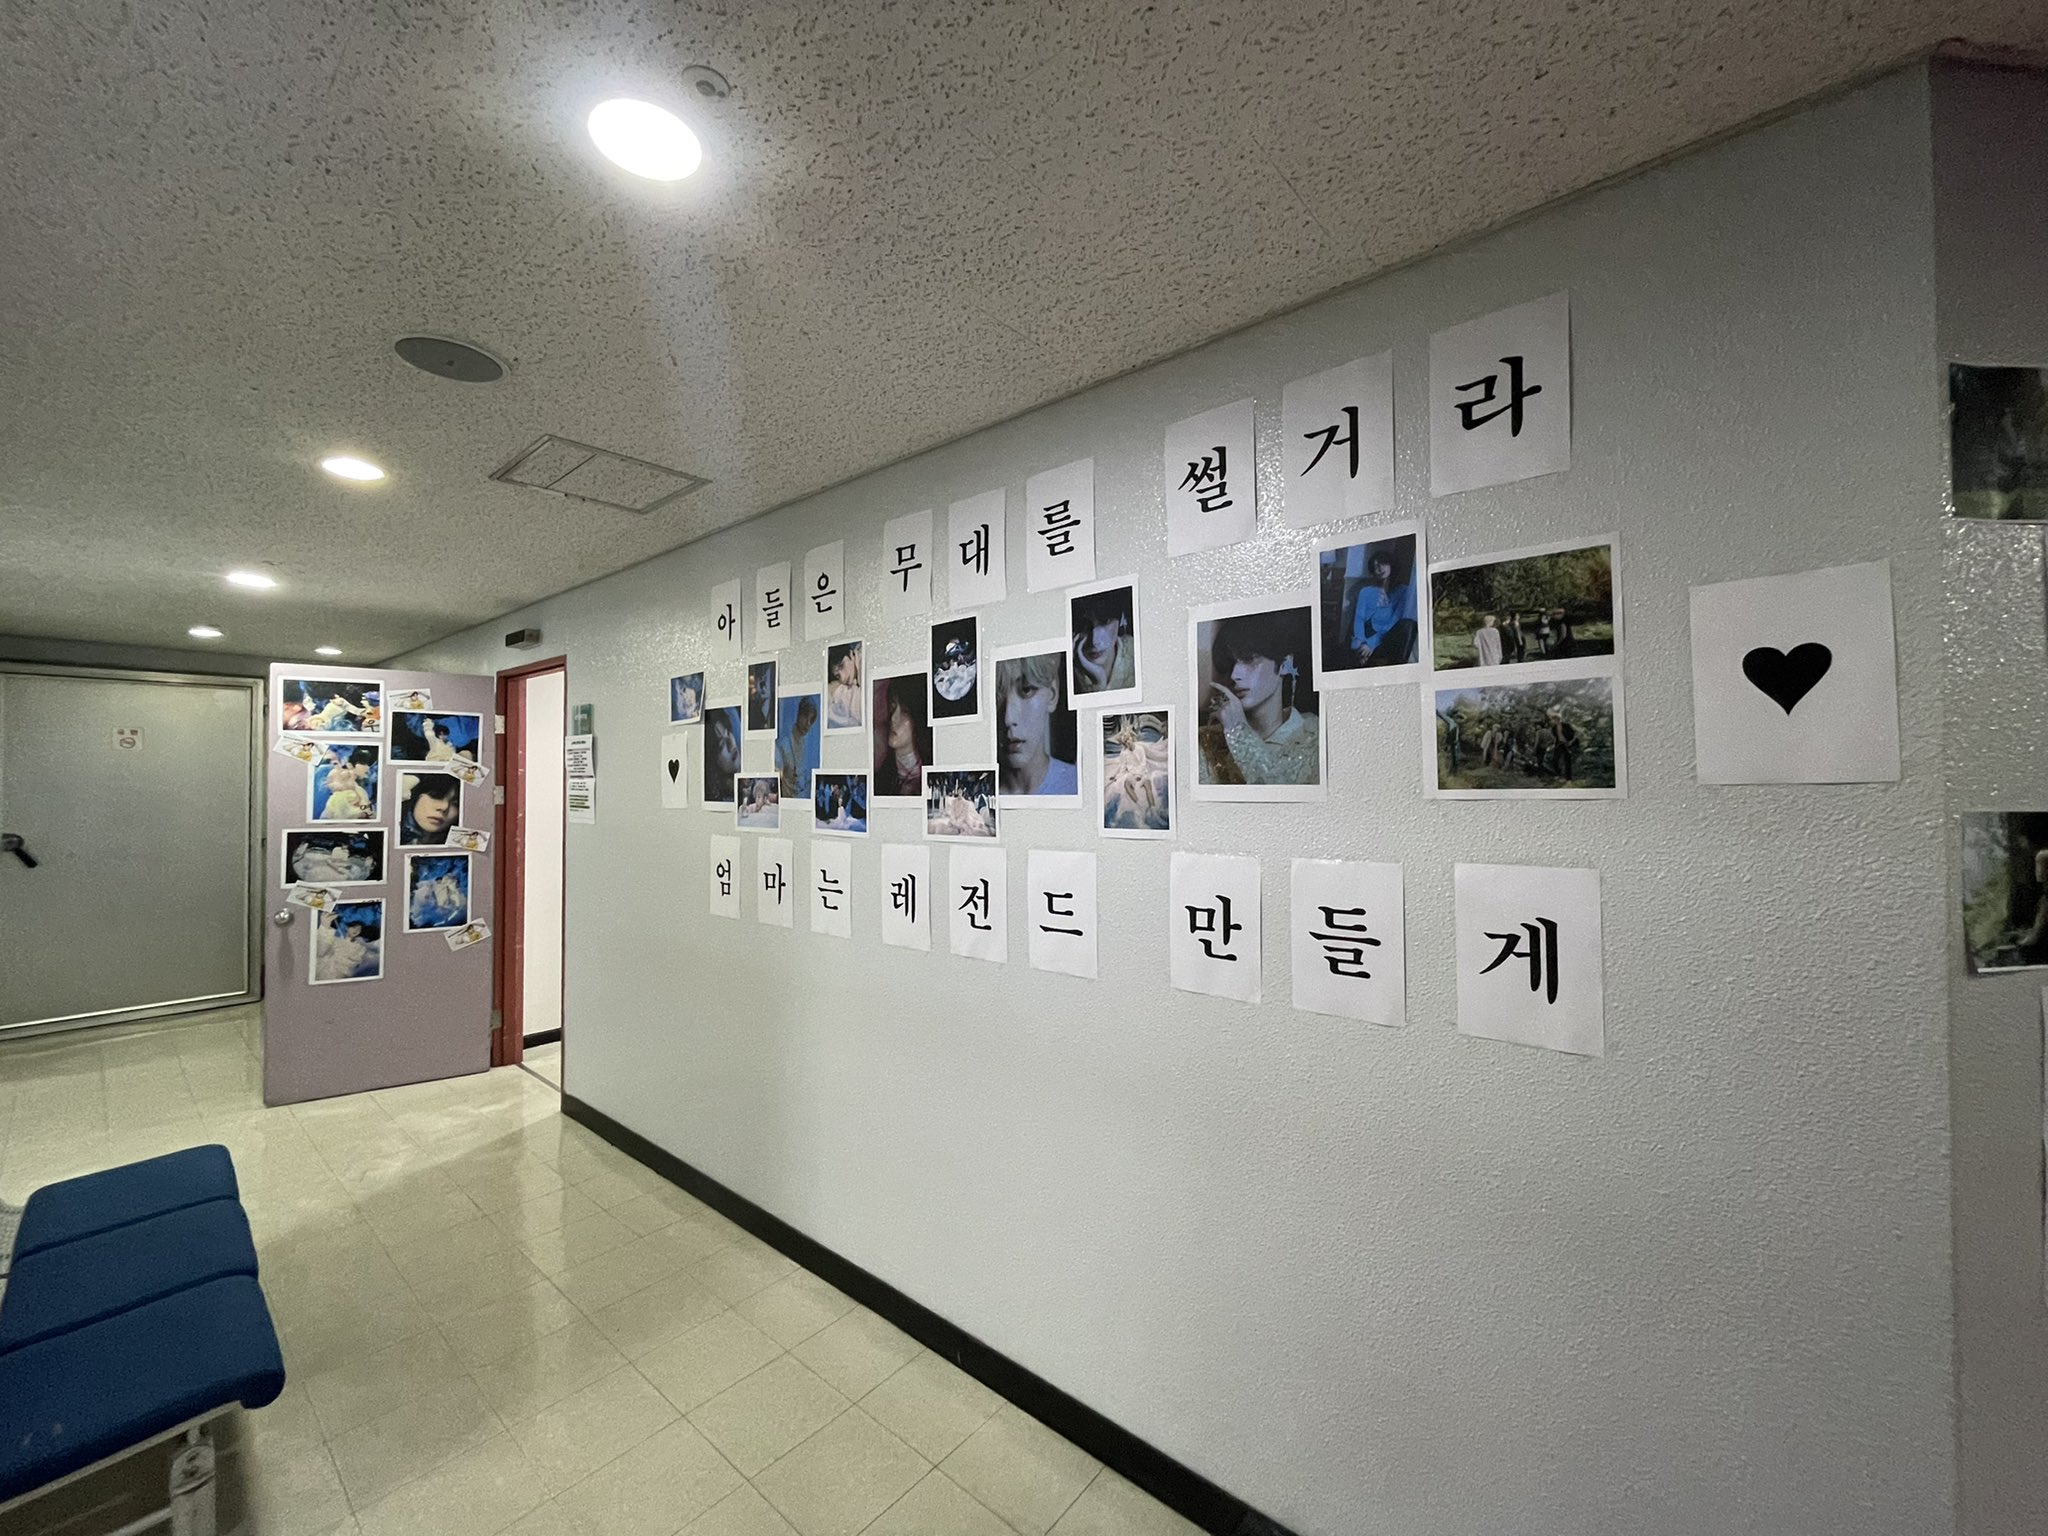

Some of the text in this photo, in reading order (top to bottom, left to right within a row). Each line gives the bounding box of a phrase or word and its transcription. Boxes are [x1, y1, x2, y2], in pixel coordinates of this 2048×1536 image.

[717, 355, 1543, 641] 아들은 무대를 썰거라
[716, 858, 1559, 1005] 엄마는 레전드 만들게
